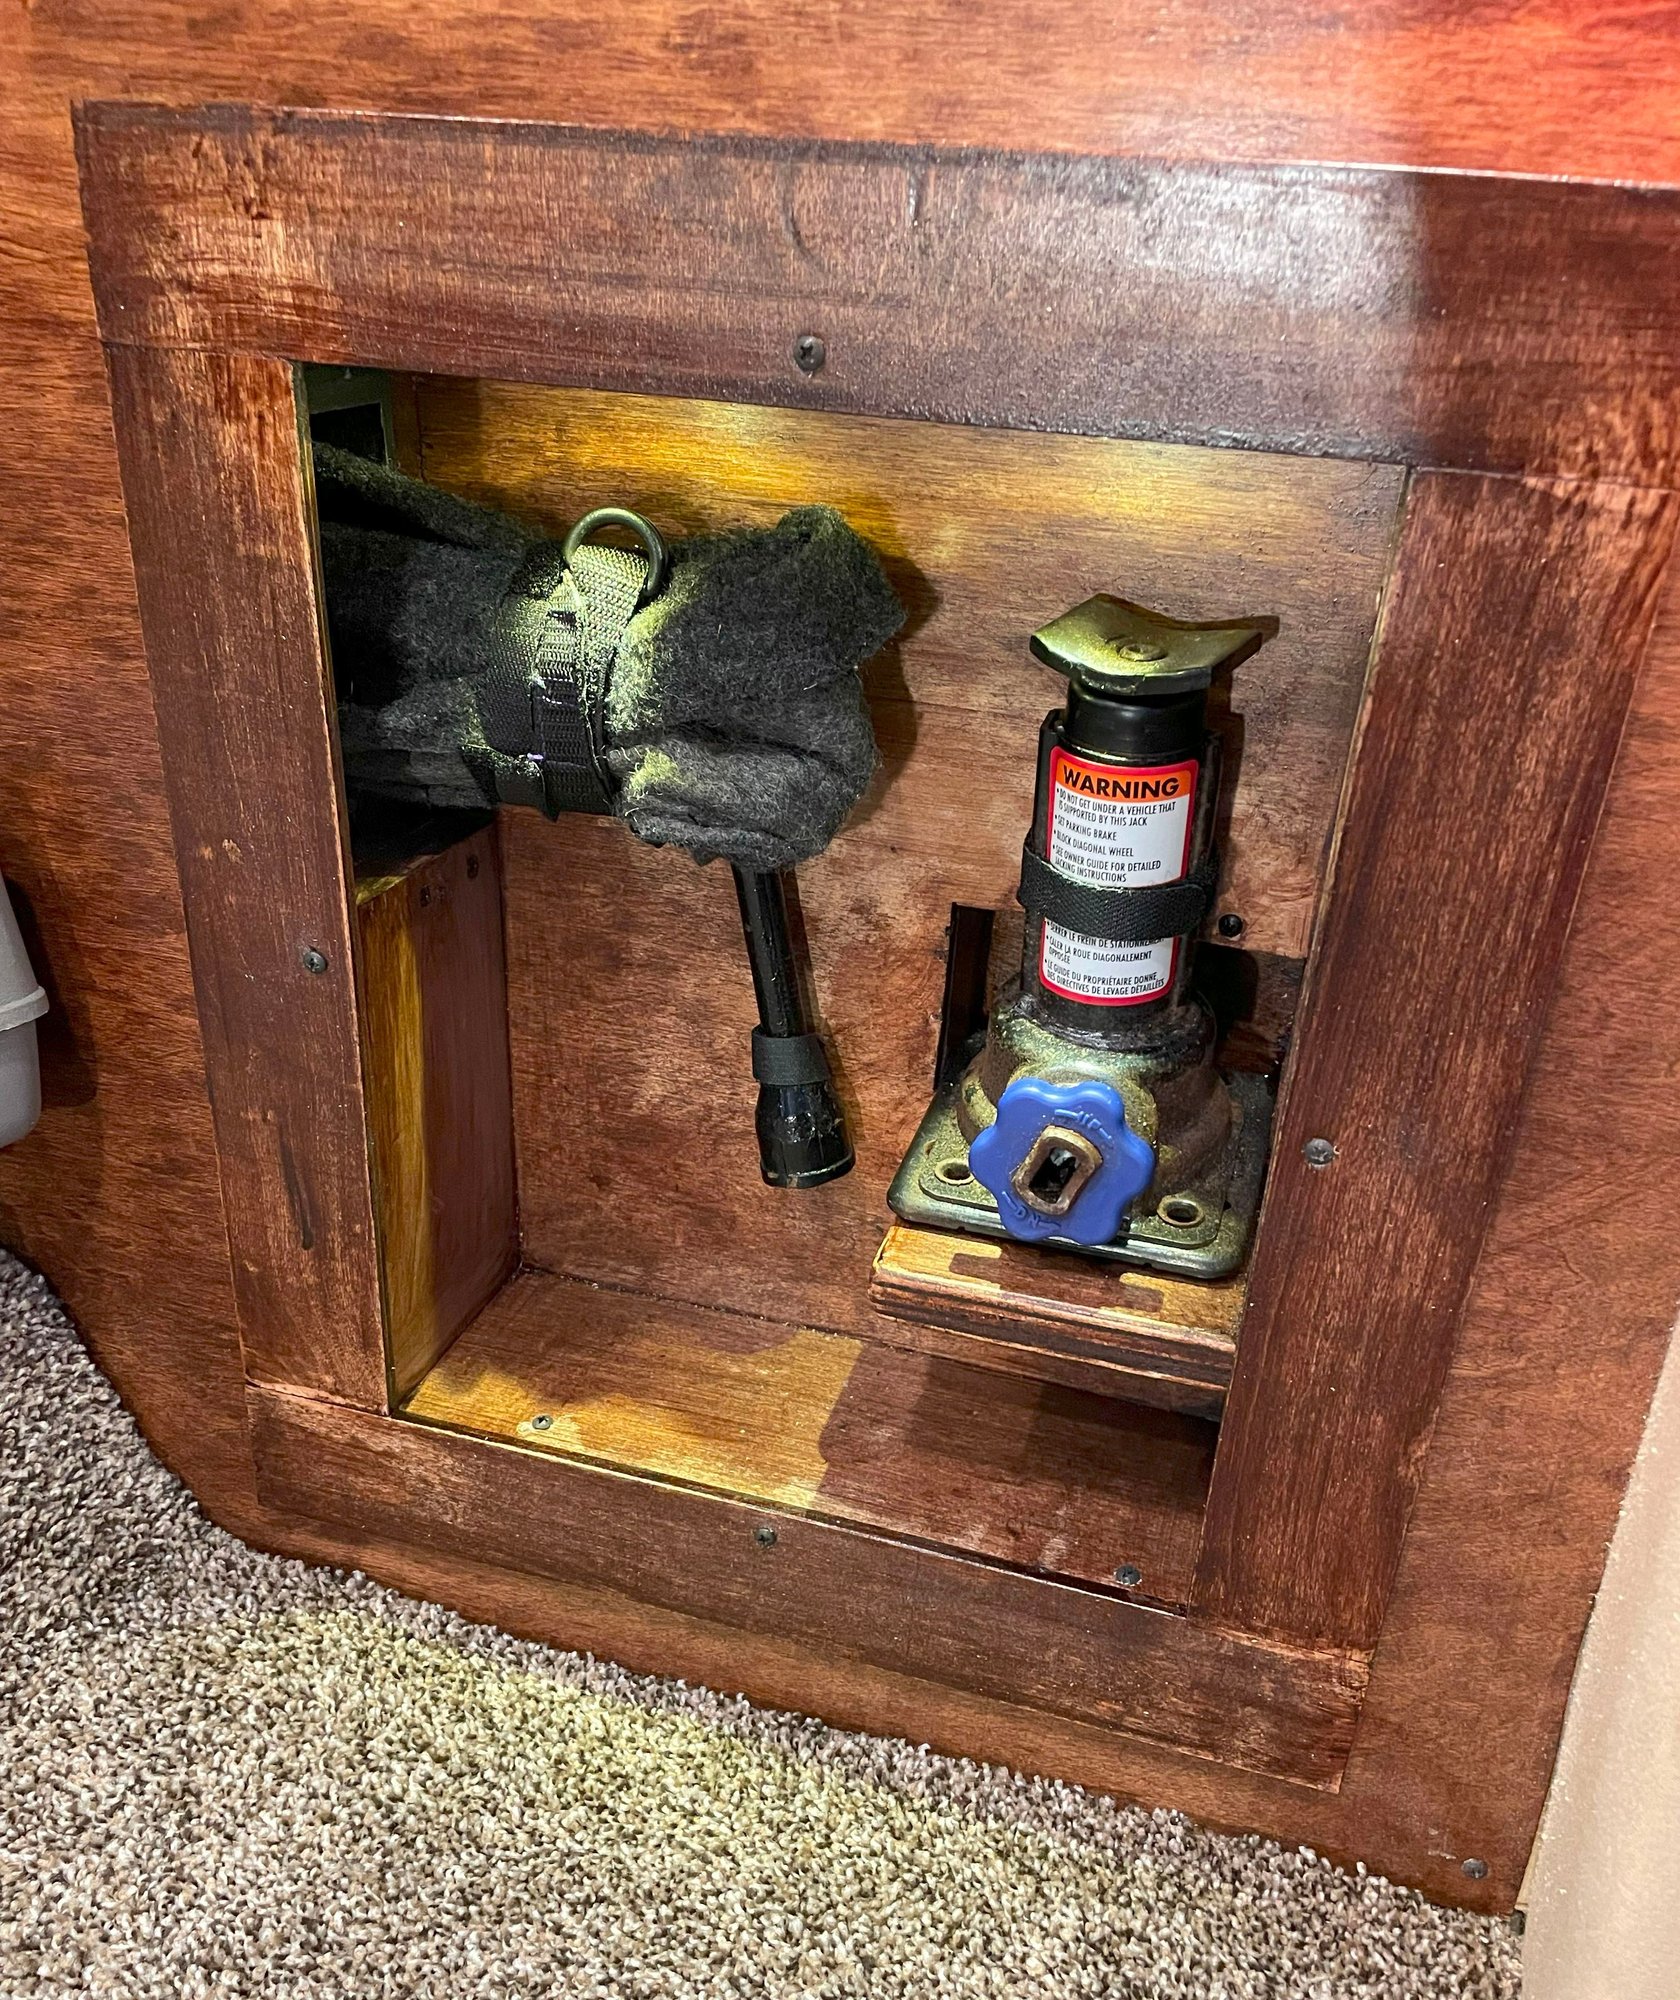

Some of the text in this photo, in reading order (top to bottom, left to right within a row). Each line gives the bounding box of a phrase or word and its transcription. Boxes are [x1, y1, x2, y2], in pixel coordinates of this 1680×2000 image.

[1063, 765, 1179, 798] WARNING
[1058, 800, 1148, 826] IS SUPPORTED BY THIS JACK
[1059, 788, 1177, 815] DO NOT GET UNDER A VEHICLE THAT
[1057, 814, 1117, 841] SET PARKING BRAKE
[1056, 830, 1134, 857] BLOCK DIAGONAL WHEEL
[1054, 857, 1127, 883] JACKING INSTRUCTIONS
[1055, 845, 1162, 872] SEE OWNER GUIDE FOR DETAILED
[1050, 936, 1152, 963] CALER LA ROUE DIAGONALEMENT
[1068, 932, 1076, 942] LE
[1077, 934, 1096, 947] FREIN
[1098, 939, 1108, 948] DE
[1047, 960, 1053, 970] LE
[1053, 963, 1070, 978] GUIDE
[1071, 970, 1081, 980] DU
[1083, 974, 1132, 986] PROPRIÉTAIRE
[1047, 969, 1165, 996] DES DIRECTIVES DE LEVAGE DÉTAILLÉES
